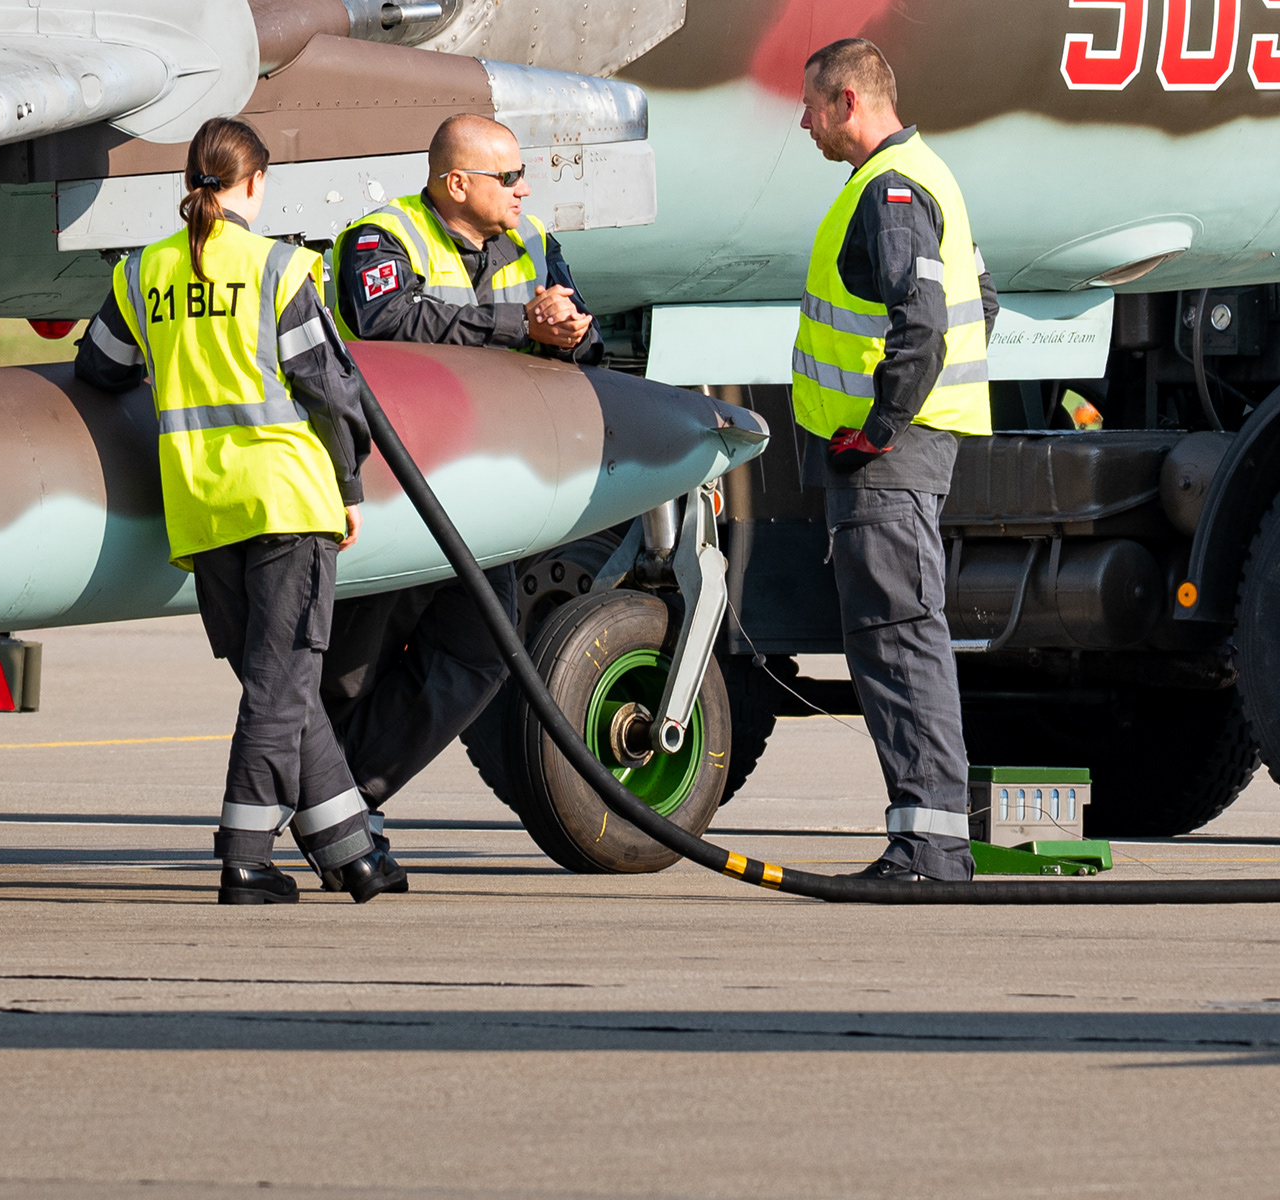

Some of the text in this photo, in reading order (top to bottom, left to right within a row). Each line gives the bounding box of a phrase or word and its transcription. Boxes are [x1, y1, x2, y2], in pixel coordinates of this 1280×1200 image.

[148, 282, 246, 324] 21 BLT
[990, 331, 1025, 345] Pielak
[1032, 330, 1066, 344] Pielak
[1068, 331, 1096, 344] Team
